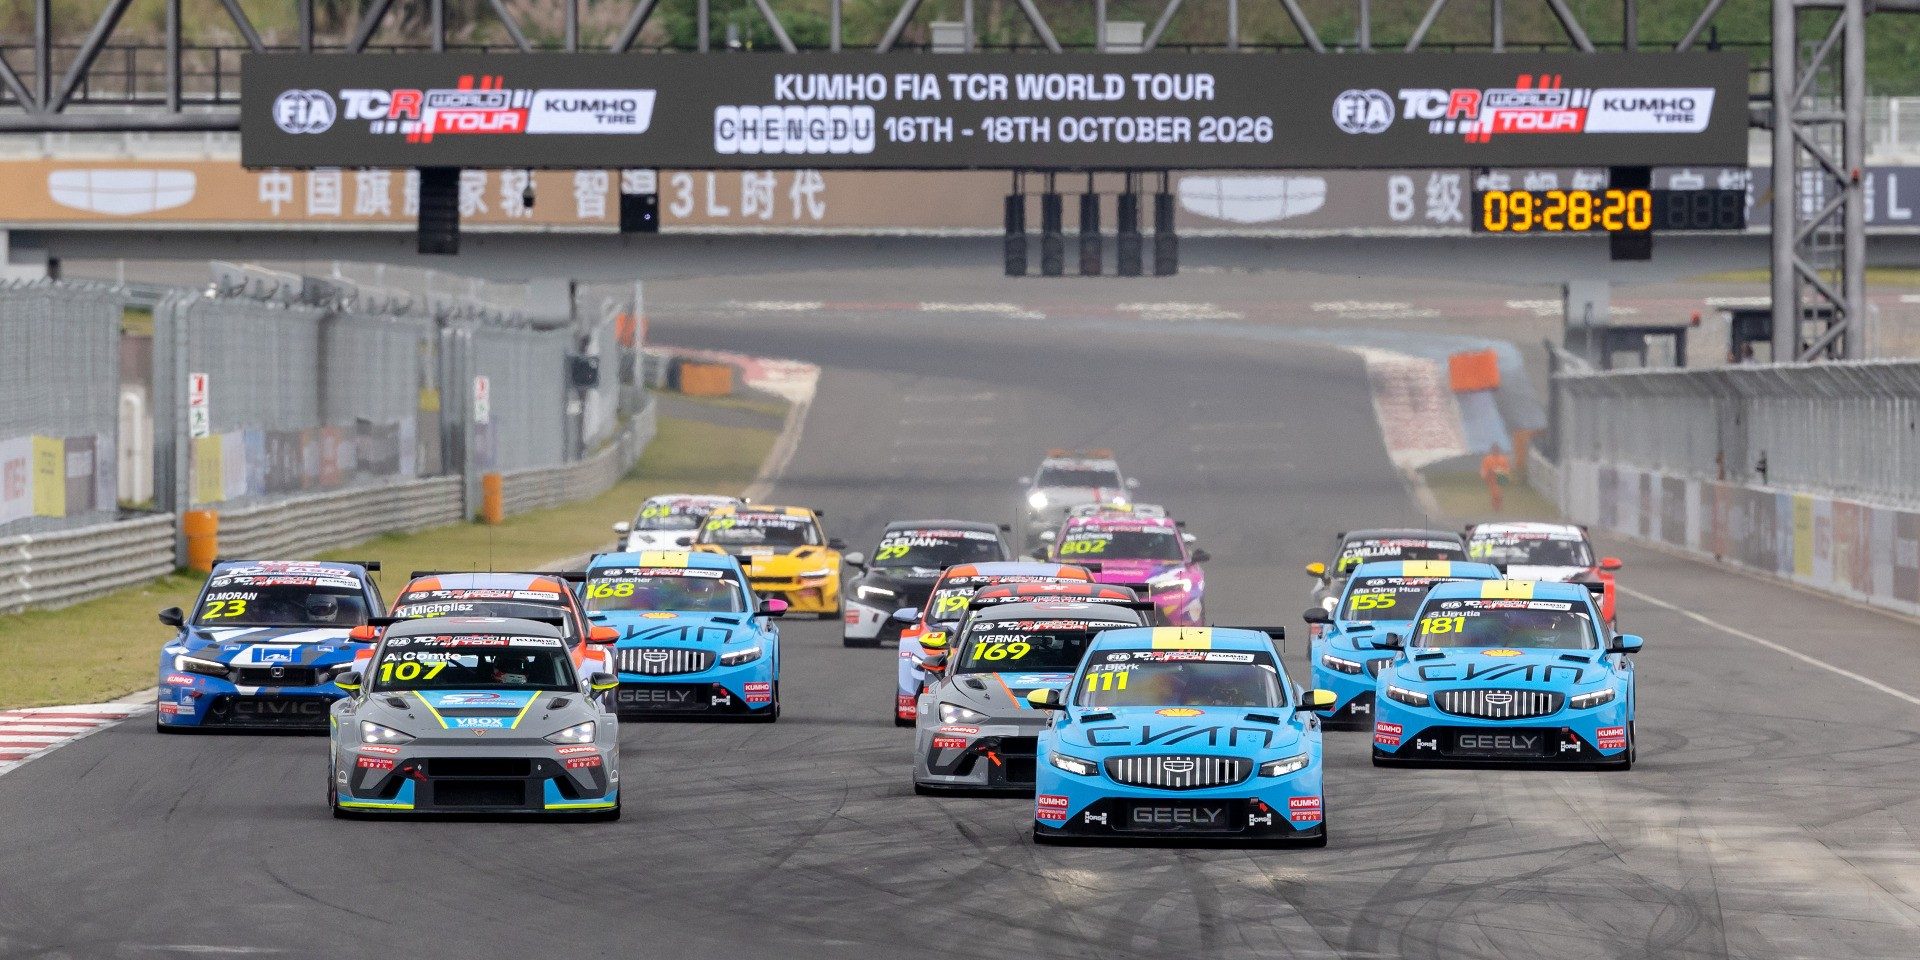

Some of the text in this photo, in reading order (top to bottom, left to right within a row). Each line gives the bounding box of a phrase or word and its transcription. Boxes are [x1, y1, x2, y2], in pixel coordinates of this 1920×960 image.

[773, 73, 1215, 101] KUMHO FIA TCR WORLD TOUR
[339, 89, 423, 120] TCR
[429, 94, 506, 107] WORLD
[545, 99, 637, 112] KUMHO
[1398, 88, 1482, 119] TCR
[1489, 93, 1564, 107] WORLD
[1603, 98, 1696, 112] KUMHO
[278, 99, 331, 124] FIA
[595, 114, 637, 124] TIRE
[1338, 99, 1389, 124] FIA
[1654, 113, 1695, 123] TIRE
[441, 112, 520, 130] TOUR
[1500, 111, 1579, 129] TOUR
[718, 118, 872, 140] CHENGDU
[883, 116, 954, 142] 16TH
[981, 116, 1051, 142] 18TH
[1057, 116, 1192, 142] OCTOBER
[1199, 116, 1274, 142] 2026
[1483, 190, 1651, 231] 09:28:20
[875, 545, 910, 561] 29
[1060, 539, 1108, 555] 802
[206, 592, 258, 601] D.MORAN
[586, 582, 636, 600] 168
[202, 599, 248, 620] 23
[395, 602, 474, 617] N.Michelisz
[1350, 593, 1397, 611] 155
[997, 621, 1035, 629] TCR
[1420, 616, 1466, 635] 181
[413, 635, 453, 644] TCR
[978, 634, 1032, 643] VERNAY
[384, 651, 462, 663] A.Comte
[972, 642, 1032, 661] 169
[1108, 653, 1129, 662] FIA
[380, 661, 449, 682] 107
[1419, 663, 1584, 684] CYAN
[167, 676, 194, 684] KUMHO
[1085, 671, 1130, 692] 111
[618, 689, 691, 702] GEELY
[234, 701, 322, 715] CIVIC
[941, 727, 978, 735] KUMHO
[1377, 723, 1402, 733] KUMHO
[1597, 728, 1624, 737] KUMHO
[1087, 725, 1274, 748] CYAN
[1459, 734, 1539, 749] GEELY
[361, 746, 399, 754] KUMHO
[558, 746, 596, 754] KUMHO
[1039, 797, 1068, 806] KUMHO
[1290, 799, 1320, 807] KUMHO
[1133, 807, 1223, 824] GEELY
